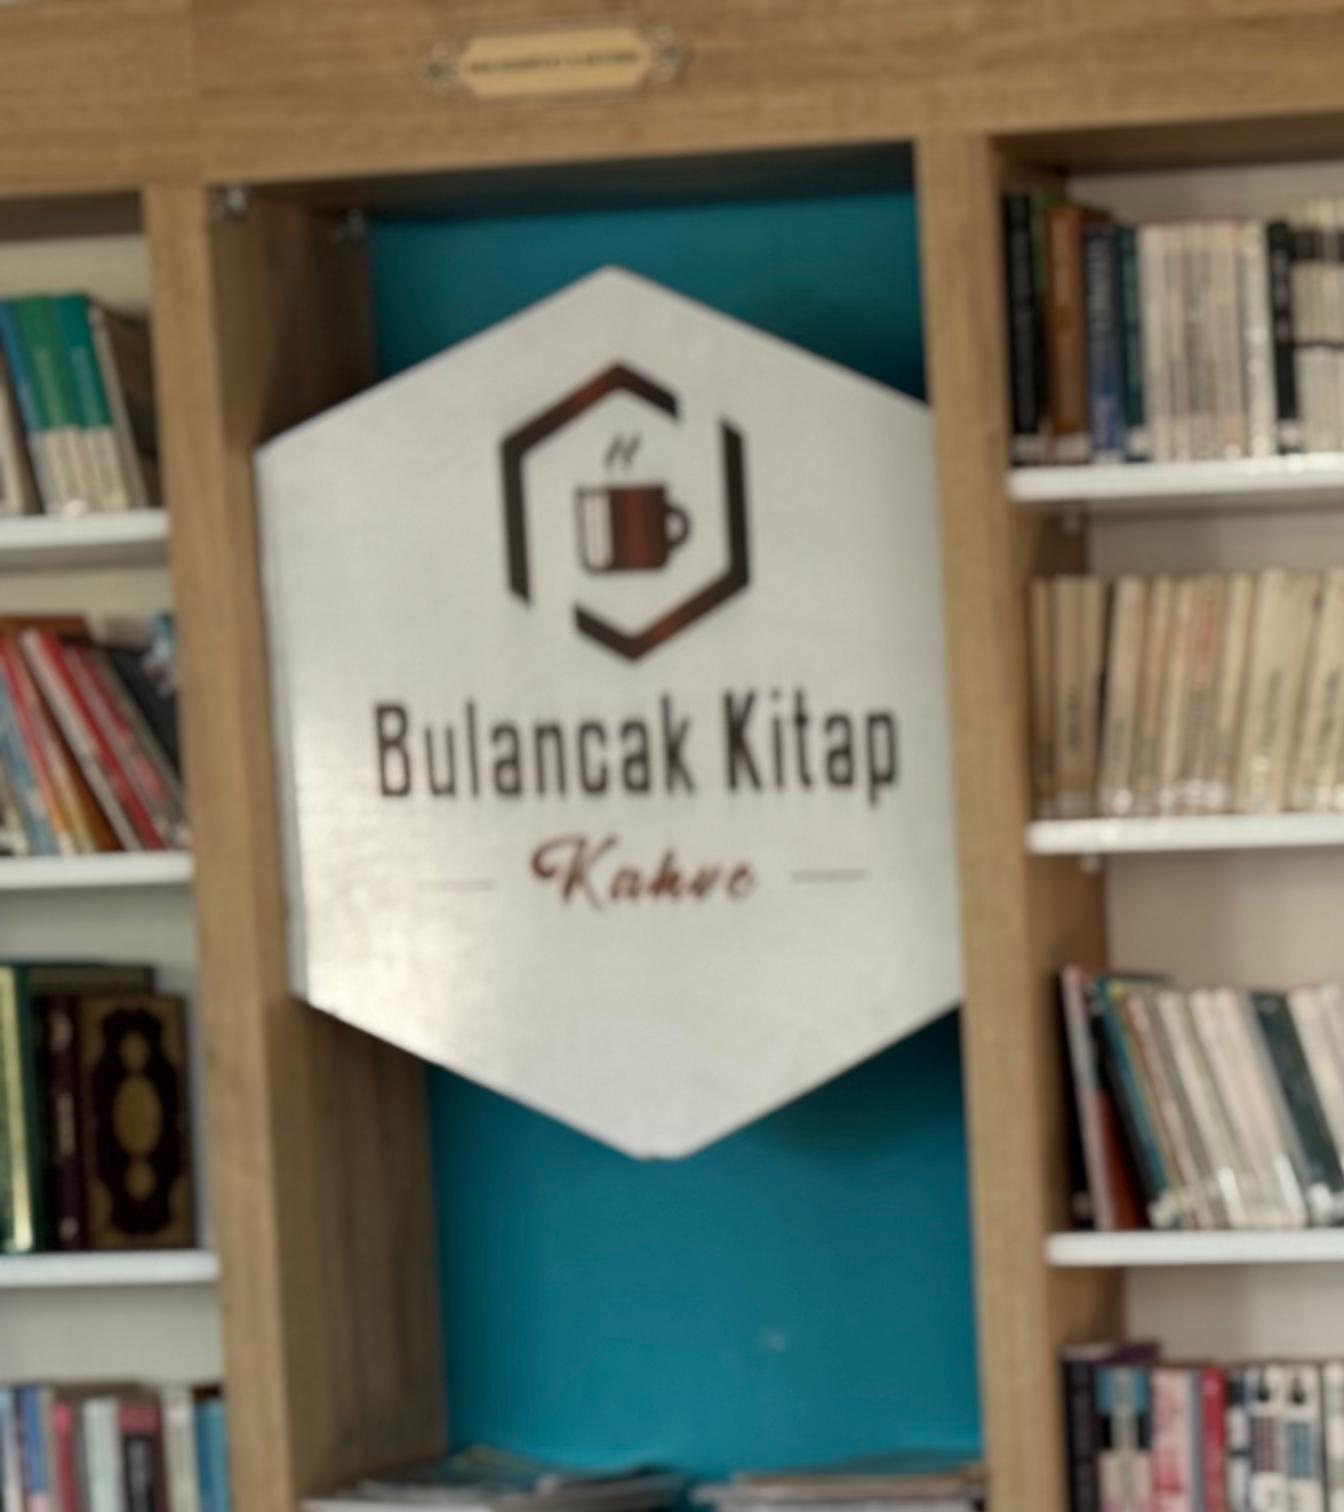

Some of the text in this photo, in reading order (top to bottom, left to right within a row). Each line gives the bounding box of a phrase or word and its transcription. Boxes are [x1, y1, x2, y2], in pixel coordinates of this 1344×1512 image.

[373, 687, 899, 805] Bulancak Kitap
[530, 834, 761, 907] Kahve
